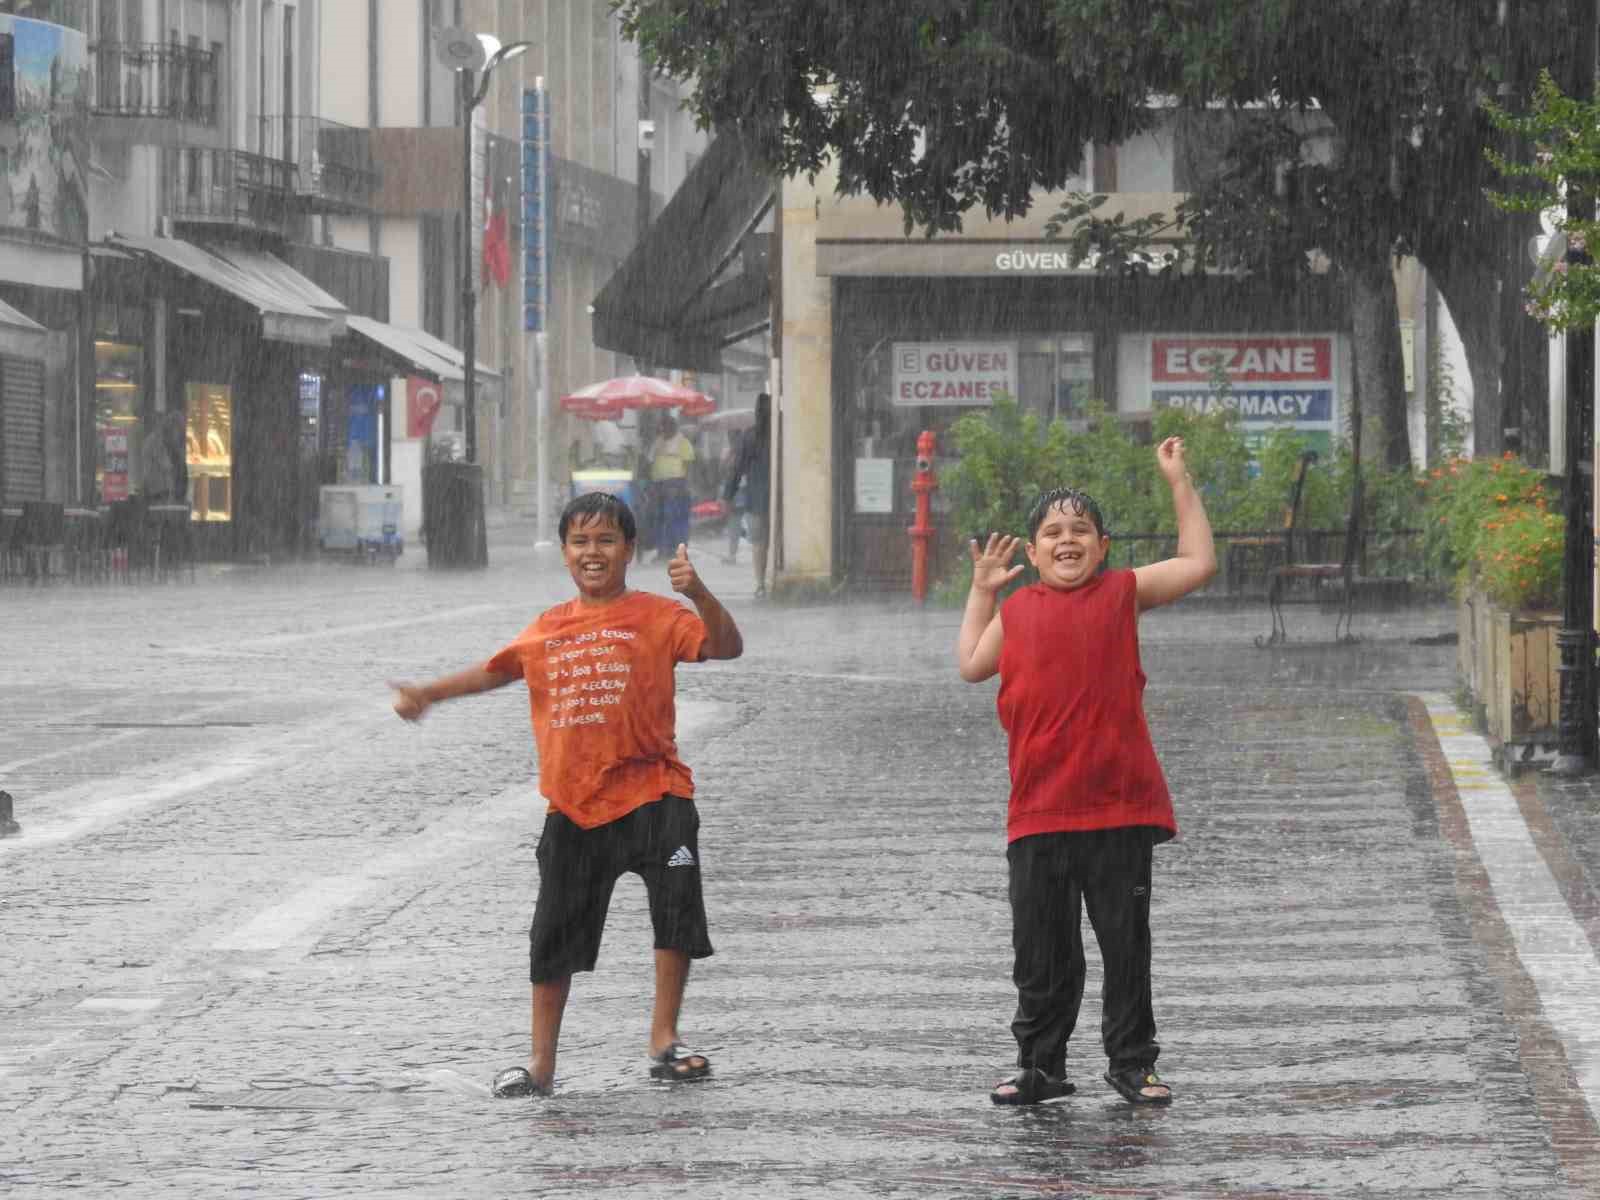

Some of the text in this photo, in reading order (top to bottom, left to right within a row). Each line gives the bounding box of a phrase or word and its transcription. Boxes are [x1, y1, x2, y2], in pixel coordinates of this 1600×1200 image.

[996, 250, 1068, 270] GÜVEN
[927, 347, 1008, 373] GÜVEN
[1166, 347, 1317, 373] ECZANE
